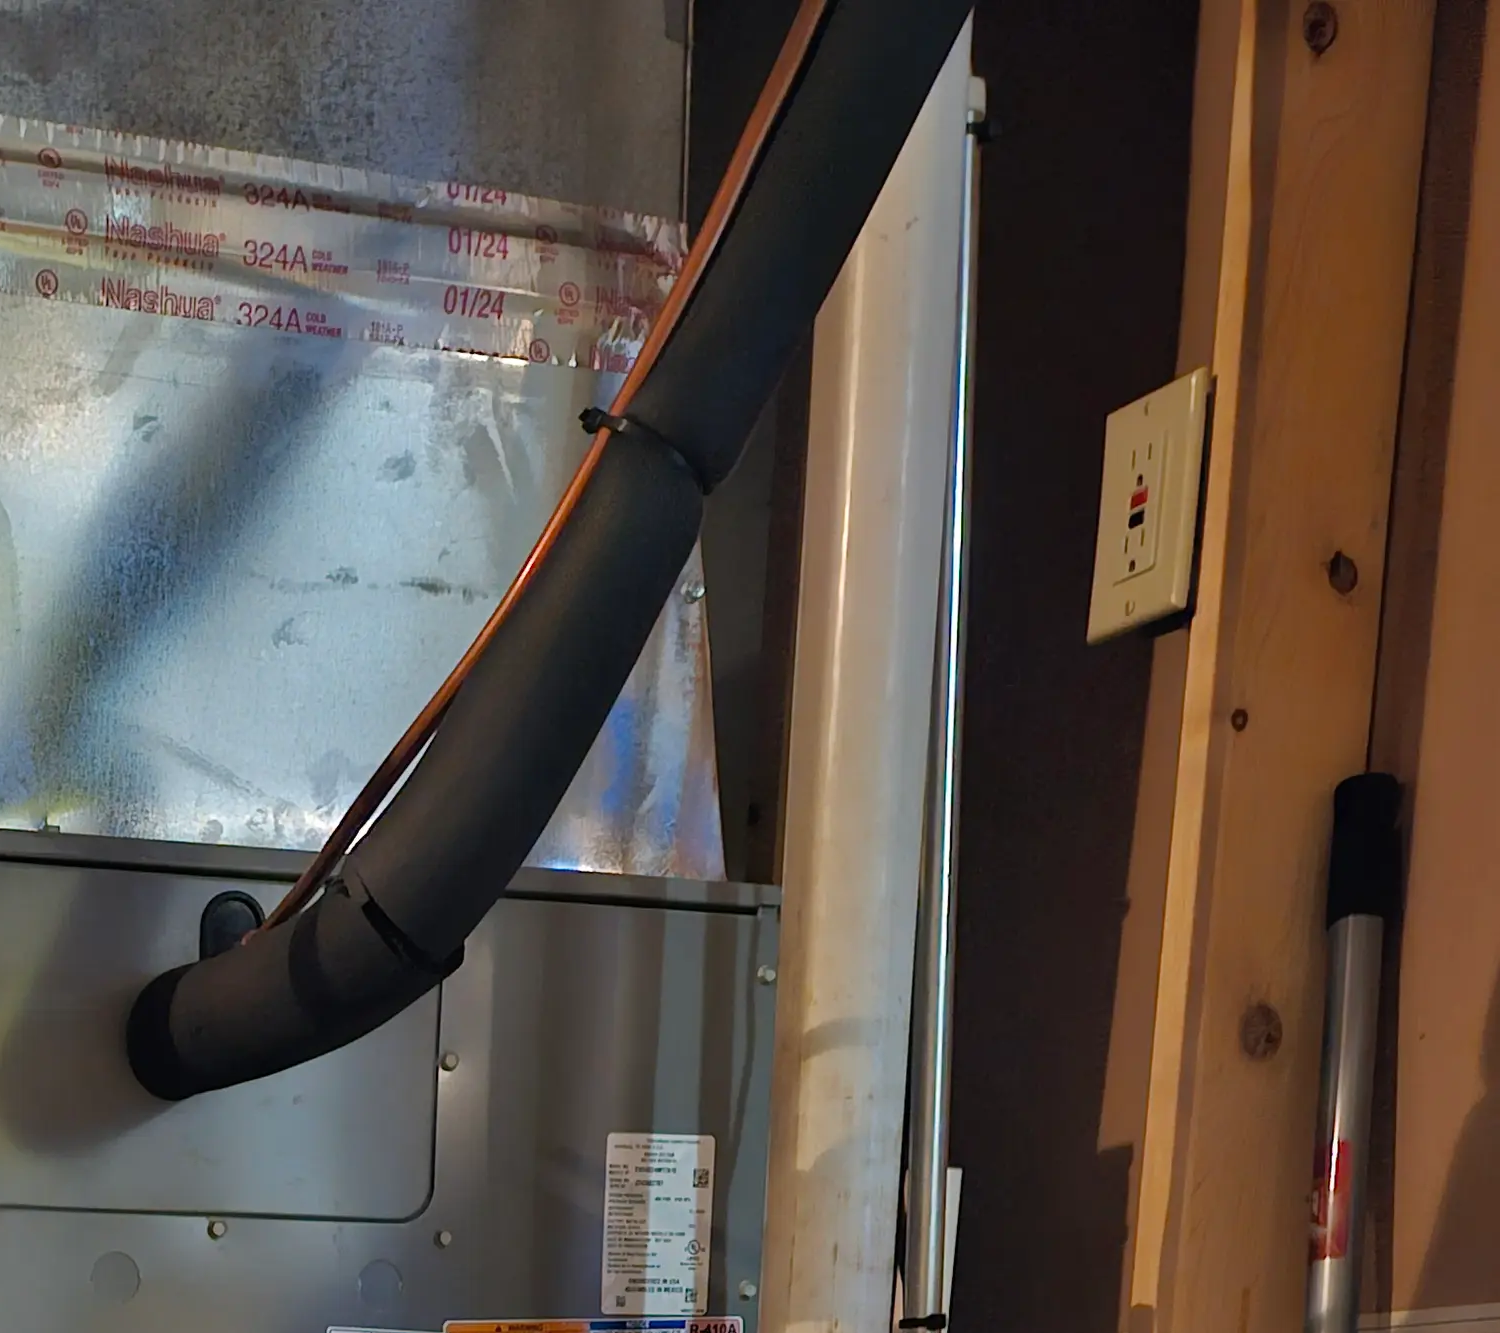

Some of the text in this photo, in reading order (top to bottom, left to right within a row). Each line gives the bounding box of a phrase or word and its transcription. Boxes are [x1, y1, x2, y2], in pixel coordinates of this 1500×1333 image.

[105, 214, 309, 274] Nashua 324A
[448, 226, 510, 261] 01/24
[101, 276, 302, 334] Nashua 324A
[305, 311, 327, 324] COLD
[442, 284, 505, 320] 01/24
[304, 324, 342, 339] WEATHER
